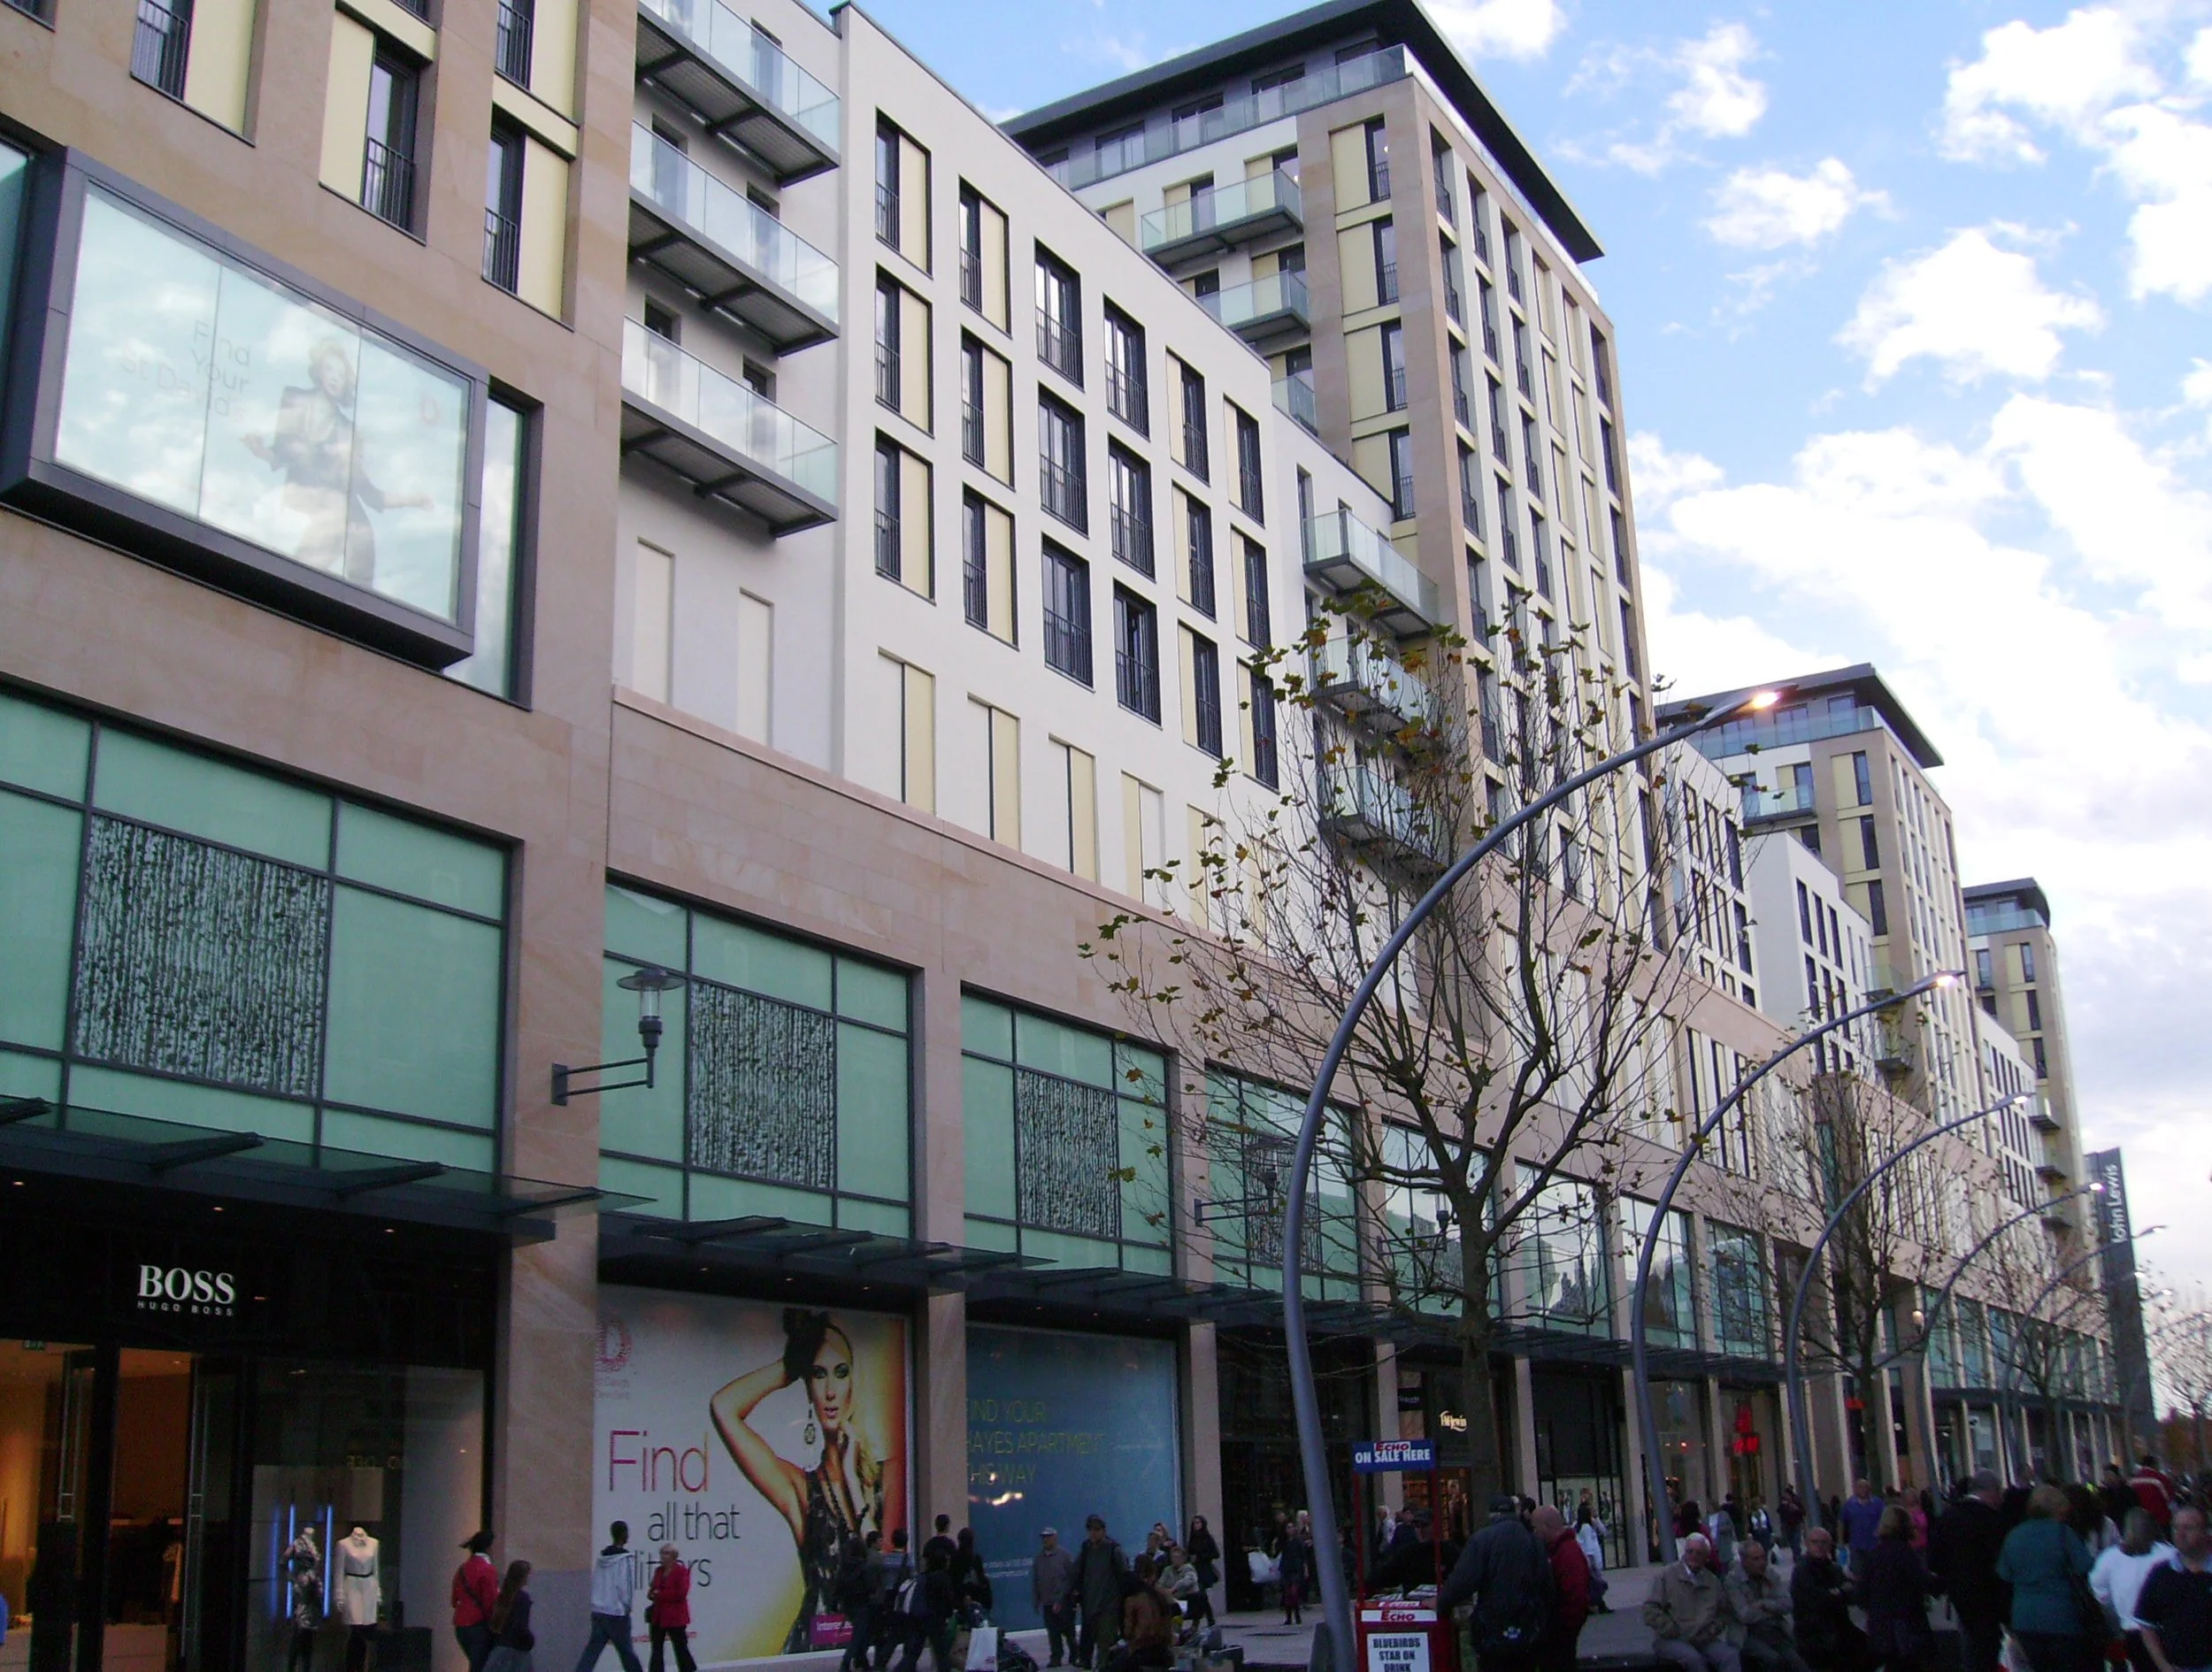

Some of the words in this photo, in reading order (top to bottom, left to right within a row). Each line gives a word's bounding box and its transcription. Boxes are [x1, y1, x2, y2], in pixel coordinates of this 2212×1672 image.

[192, 319, 250, 366] Fnd
[2102, 1163, 2122, 1207] Lewis
[2109, 1208, 2127, 1244] John
[137, 1264, 235, 1304] BOSS
[137, 1300, 181, 1313] HUGO
[191, 1305, 234, 1316] BOSS
[966, 1399, 998, 1423] IND
[1002, 1400, 1048, 1423] YOUR
[609, 1430, 709, 1492] Find
[1355, 1452, 1371, 1463] ON
[1374, 1450, 1400, 1462] SALE
[1403, 1449, 1431, 1461] HERE
[647, 1501, 677, 1541] all
[684, 1501, 740, 1540] that
[1381, 1609, 1416, 1621] ECHO
[1373, 1637, 1421, 1648] BLUEBIRDS
[1402, 1650, 1416, 1660] ON
